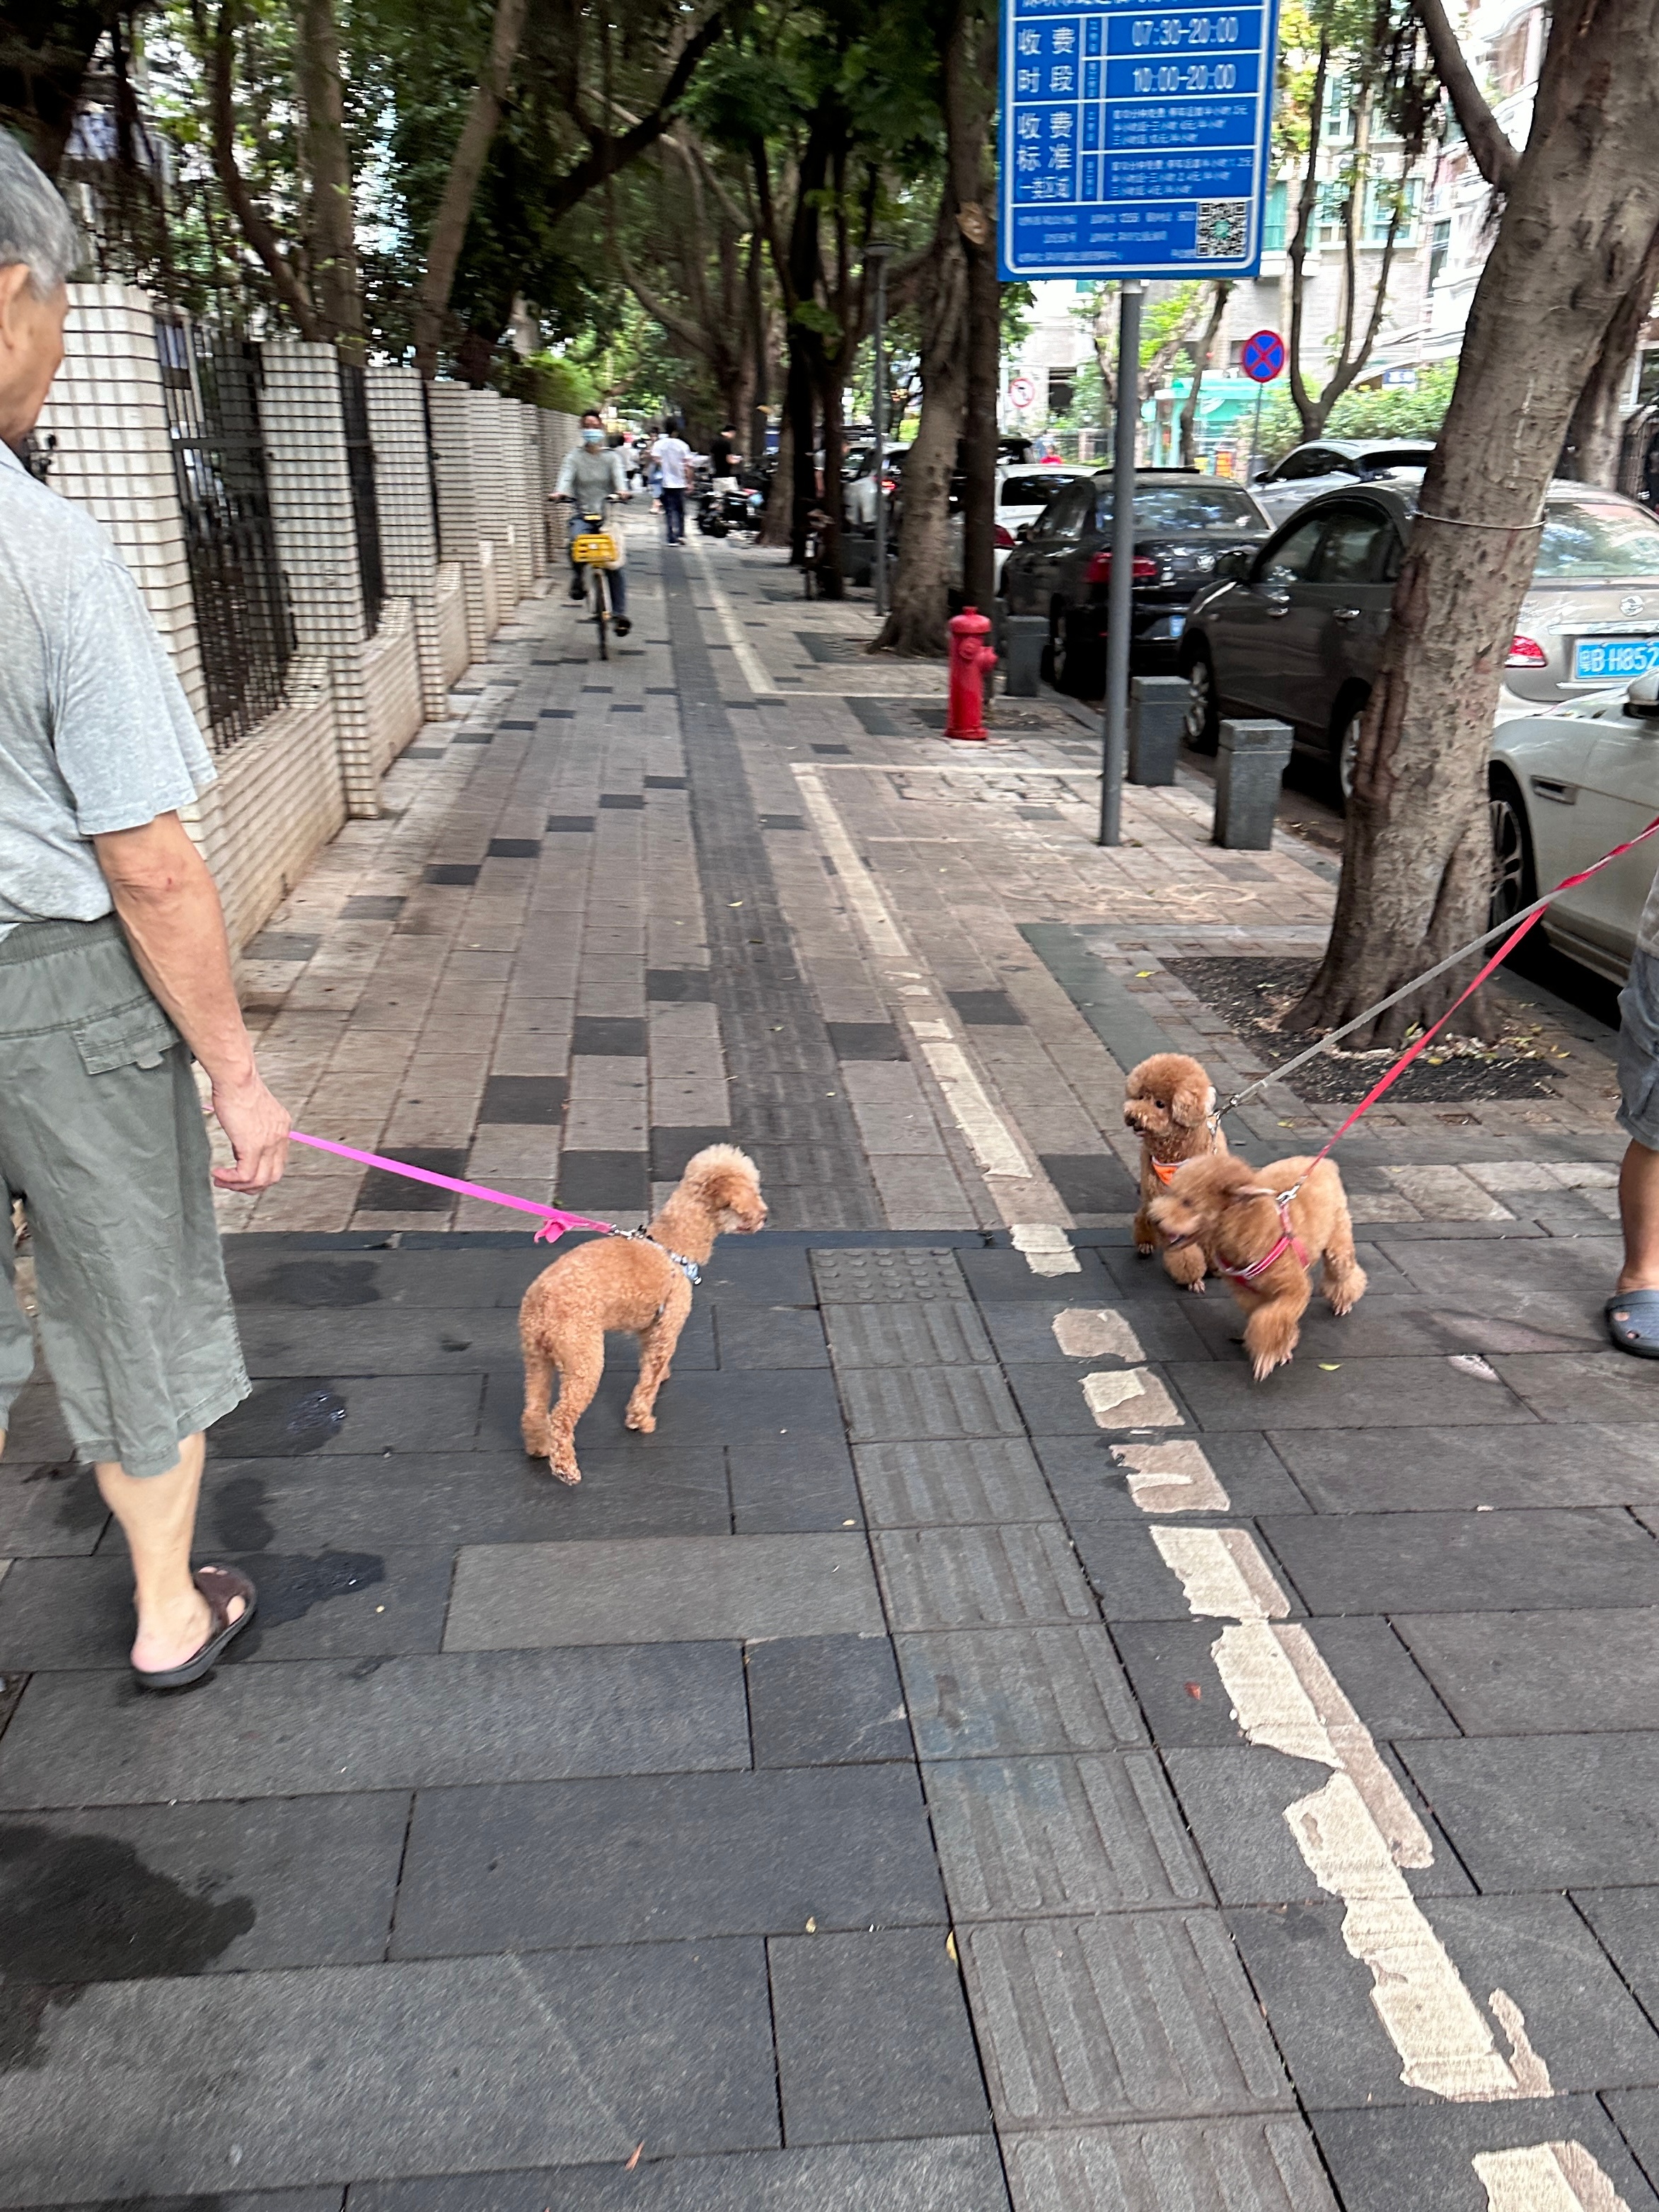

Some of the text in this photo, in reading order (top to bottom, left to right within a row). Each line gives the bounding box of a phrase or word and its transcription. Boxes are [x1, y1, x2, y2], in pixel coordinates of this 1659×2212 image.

[1017, 27, 1076, 56] 收费
[1132, 16, 1238, 47] 07:30-20:00
[1017, 65, 1075, 93] 时段
[1132, 64, 1237, 93] 10:00-20:00
[1017, 111, 1073, 139] 收费
[1017, 143, 1073, 172] 标准
